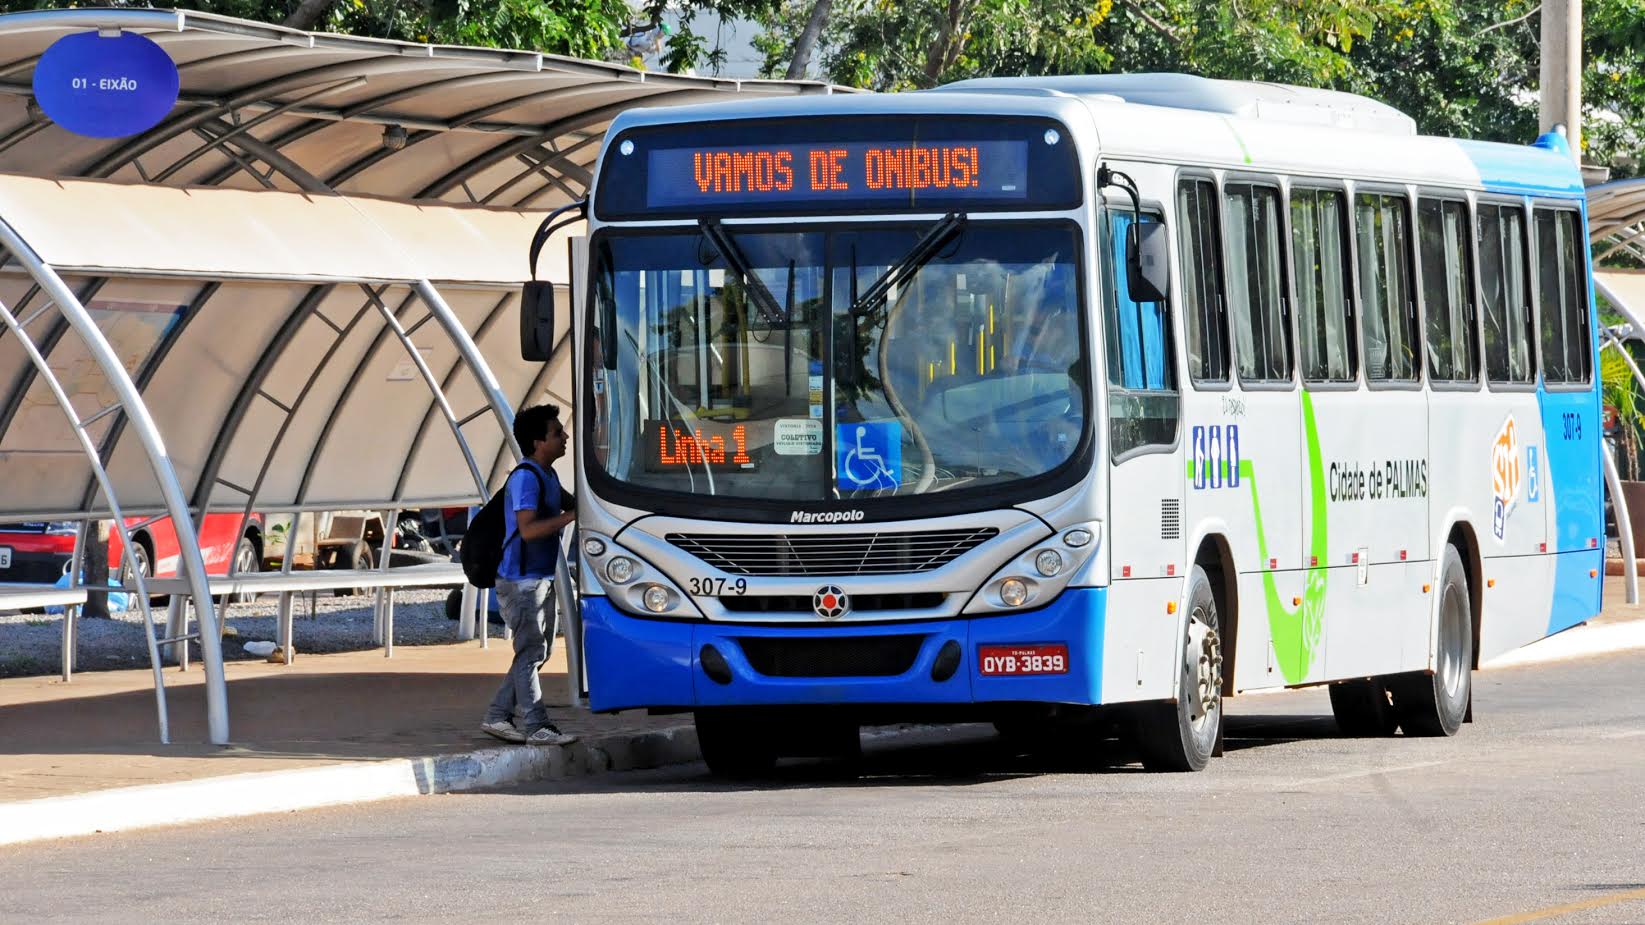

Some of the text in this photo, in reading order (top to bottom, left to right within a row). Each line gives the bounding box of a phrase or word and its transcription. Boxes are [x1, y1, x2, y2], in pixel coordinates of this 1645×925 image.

[72, 78, 87, 89] 01
[99, 77, 138, 91] EIXÃO
[694, 147, 979, 192] VAMOS DE ONIBUS!
[1562, 412, 1582, 440] 307-9
[660, 425, 750, 464] Linha 1
[1329, 458, 1427, 502] Cidade de PALMAS
[790, 510, 865, 524] Marcopolo
[689, 577, 747, 596] 307-9
